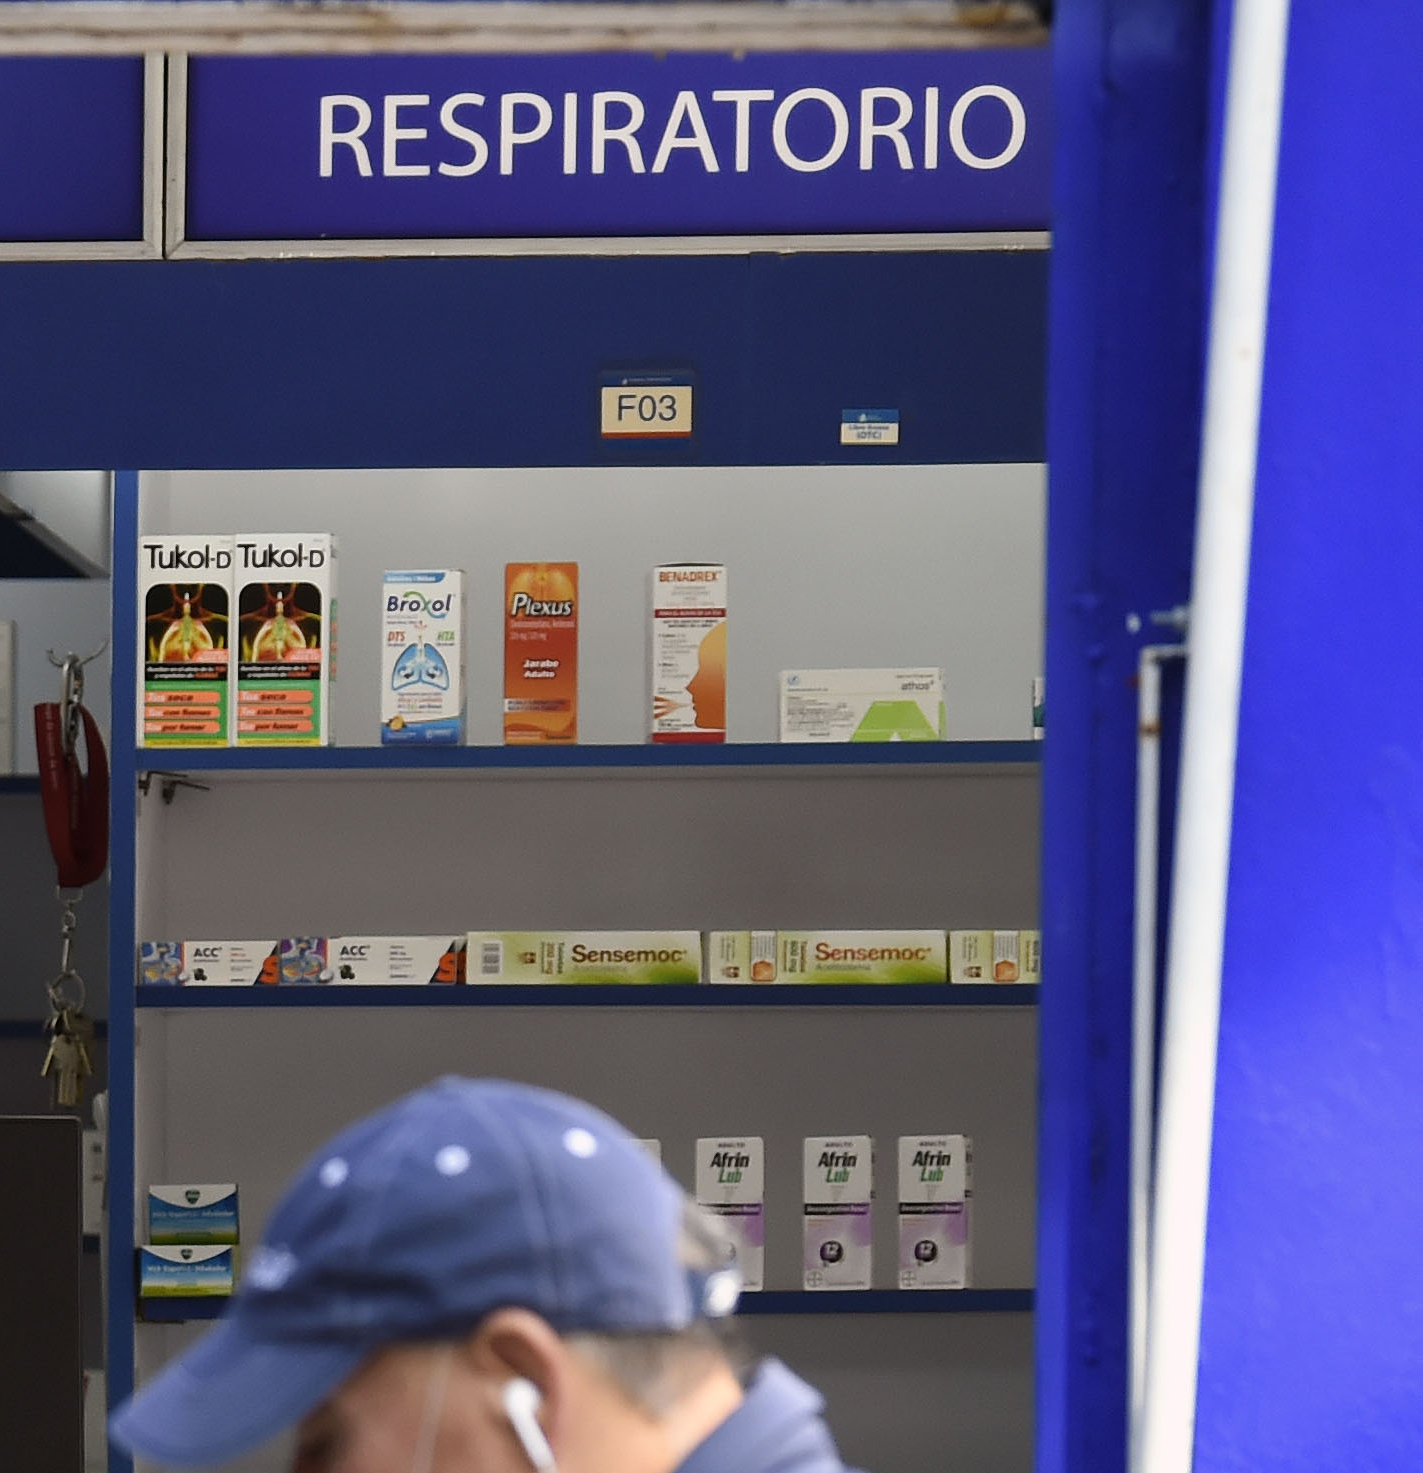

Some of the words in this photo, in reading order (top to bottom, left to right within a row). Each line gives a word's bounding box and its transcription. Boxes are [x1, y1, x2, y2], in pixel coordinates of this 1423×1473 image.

[317, 85, 1029, 178] RESPIRATORIO
[616, 394, 677, 423] F03
[144, 544, 231, 569] Tukol-D
[237, 542, 325, 568] Tukol-D
[658, 569, 718, 583] BENADREX
[386, 593, 451, 616] Broxol
[510, 592, 573, 617] Plexus
[193, 945, 218, 958] ACC
[571, 943, 682, 964] Sensemoc
[814, 942, 927, 962] Sensemoc
[711, 1150, 750, 1168] Afrin
[818, 1150, 858, 1168] Afrin
[717, 1168, 743, 1184] Lub
[825, 1168, 850, 1184] Lub
